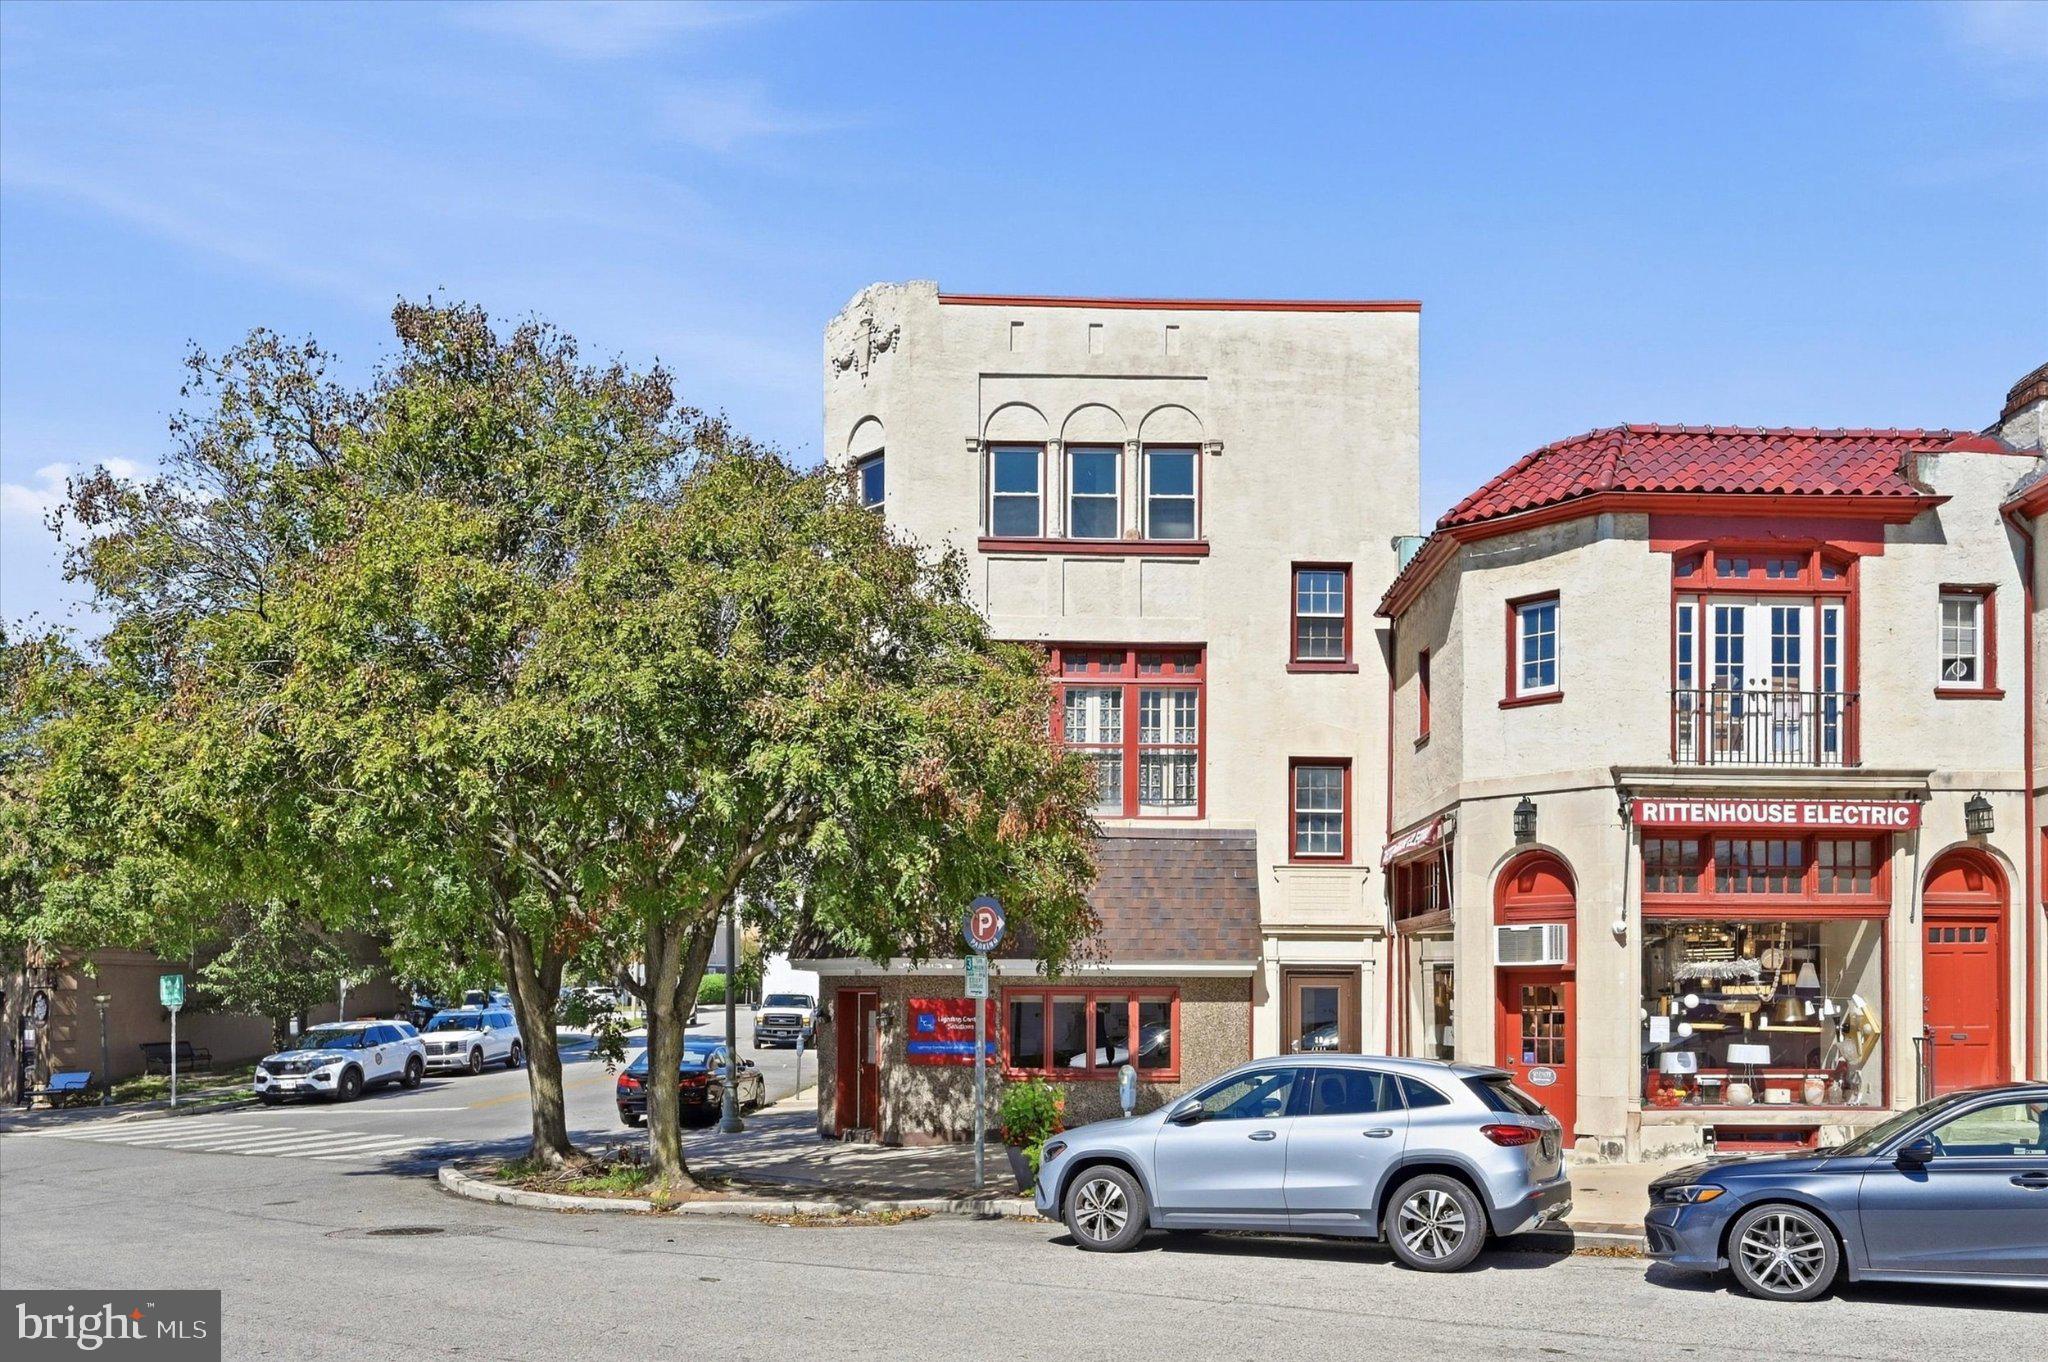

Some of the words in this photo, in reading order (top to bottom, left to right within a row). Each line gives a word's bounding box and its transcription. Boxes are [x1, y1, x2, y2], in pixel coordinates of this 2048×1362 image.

[1642, 802, 1797, 824] RITTENHOUSE
[1803, 804, 1910, 826] ELECTRIC
[978, 912, 993, 936] P
[970, 938, 999, 951] PARKING
[937, 1015, 962, 1024] Lighting
